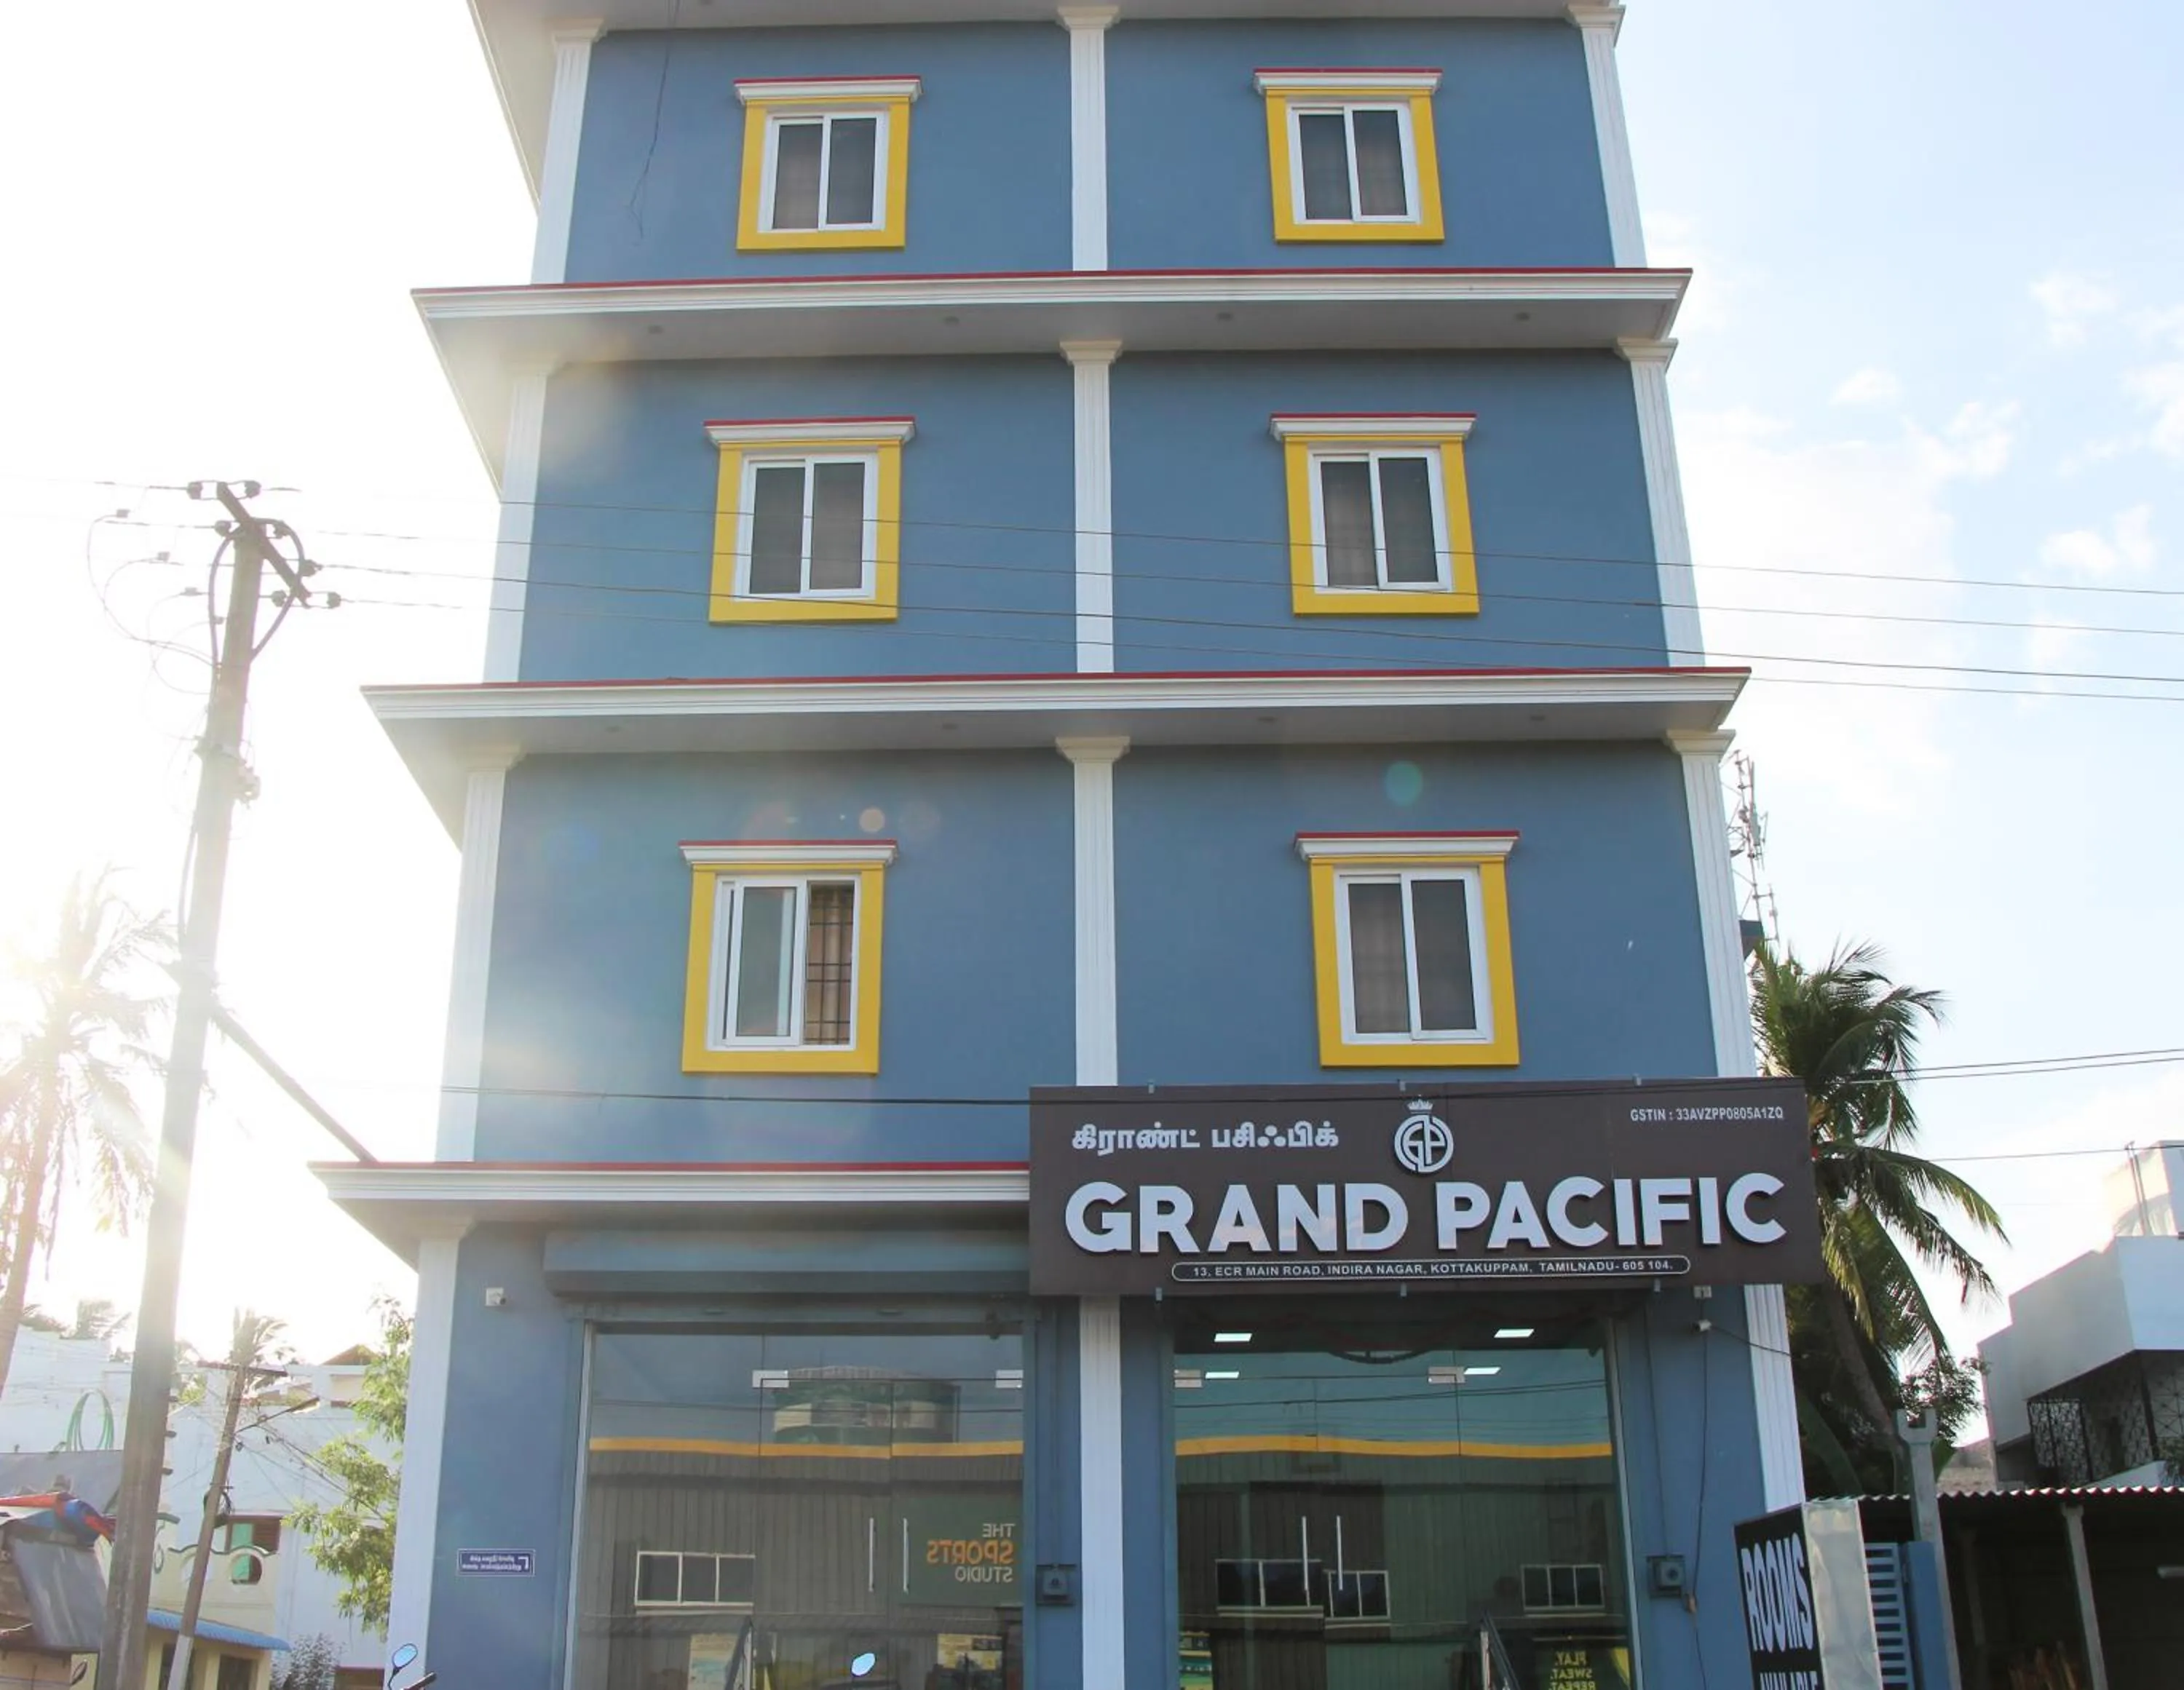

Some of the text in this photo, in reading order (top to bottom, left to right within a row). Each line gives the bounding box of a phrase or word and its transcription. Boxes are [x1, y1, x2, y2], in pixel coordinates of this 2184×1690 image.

[1630, 1108, 1666, 1122] GSTIN
[1065, 1173, 1787, 1253] GRAND PACIFIC
[1215, 1266, 1242, 1277] ECR
[1246, 1265, 1279, 1276] MAIN
[1327, 1264, 1372, 1274] INDIRA
[1623, 1261, 1644, 1270] 605
[1741, 1532, 1813, 1653] ROOMS
